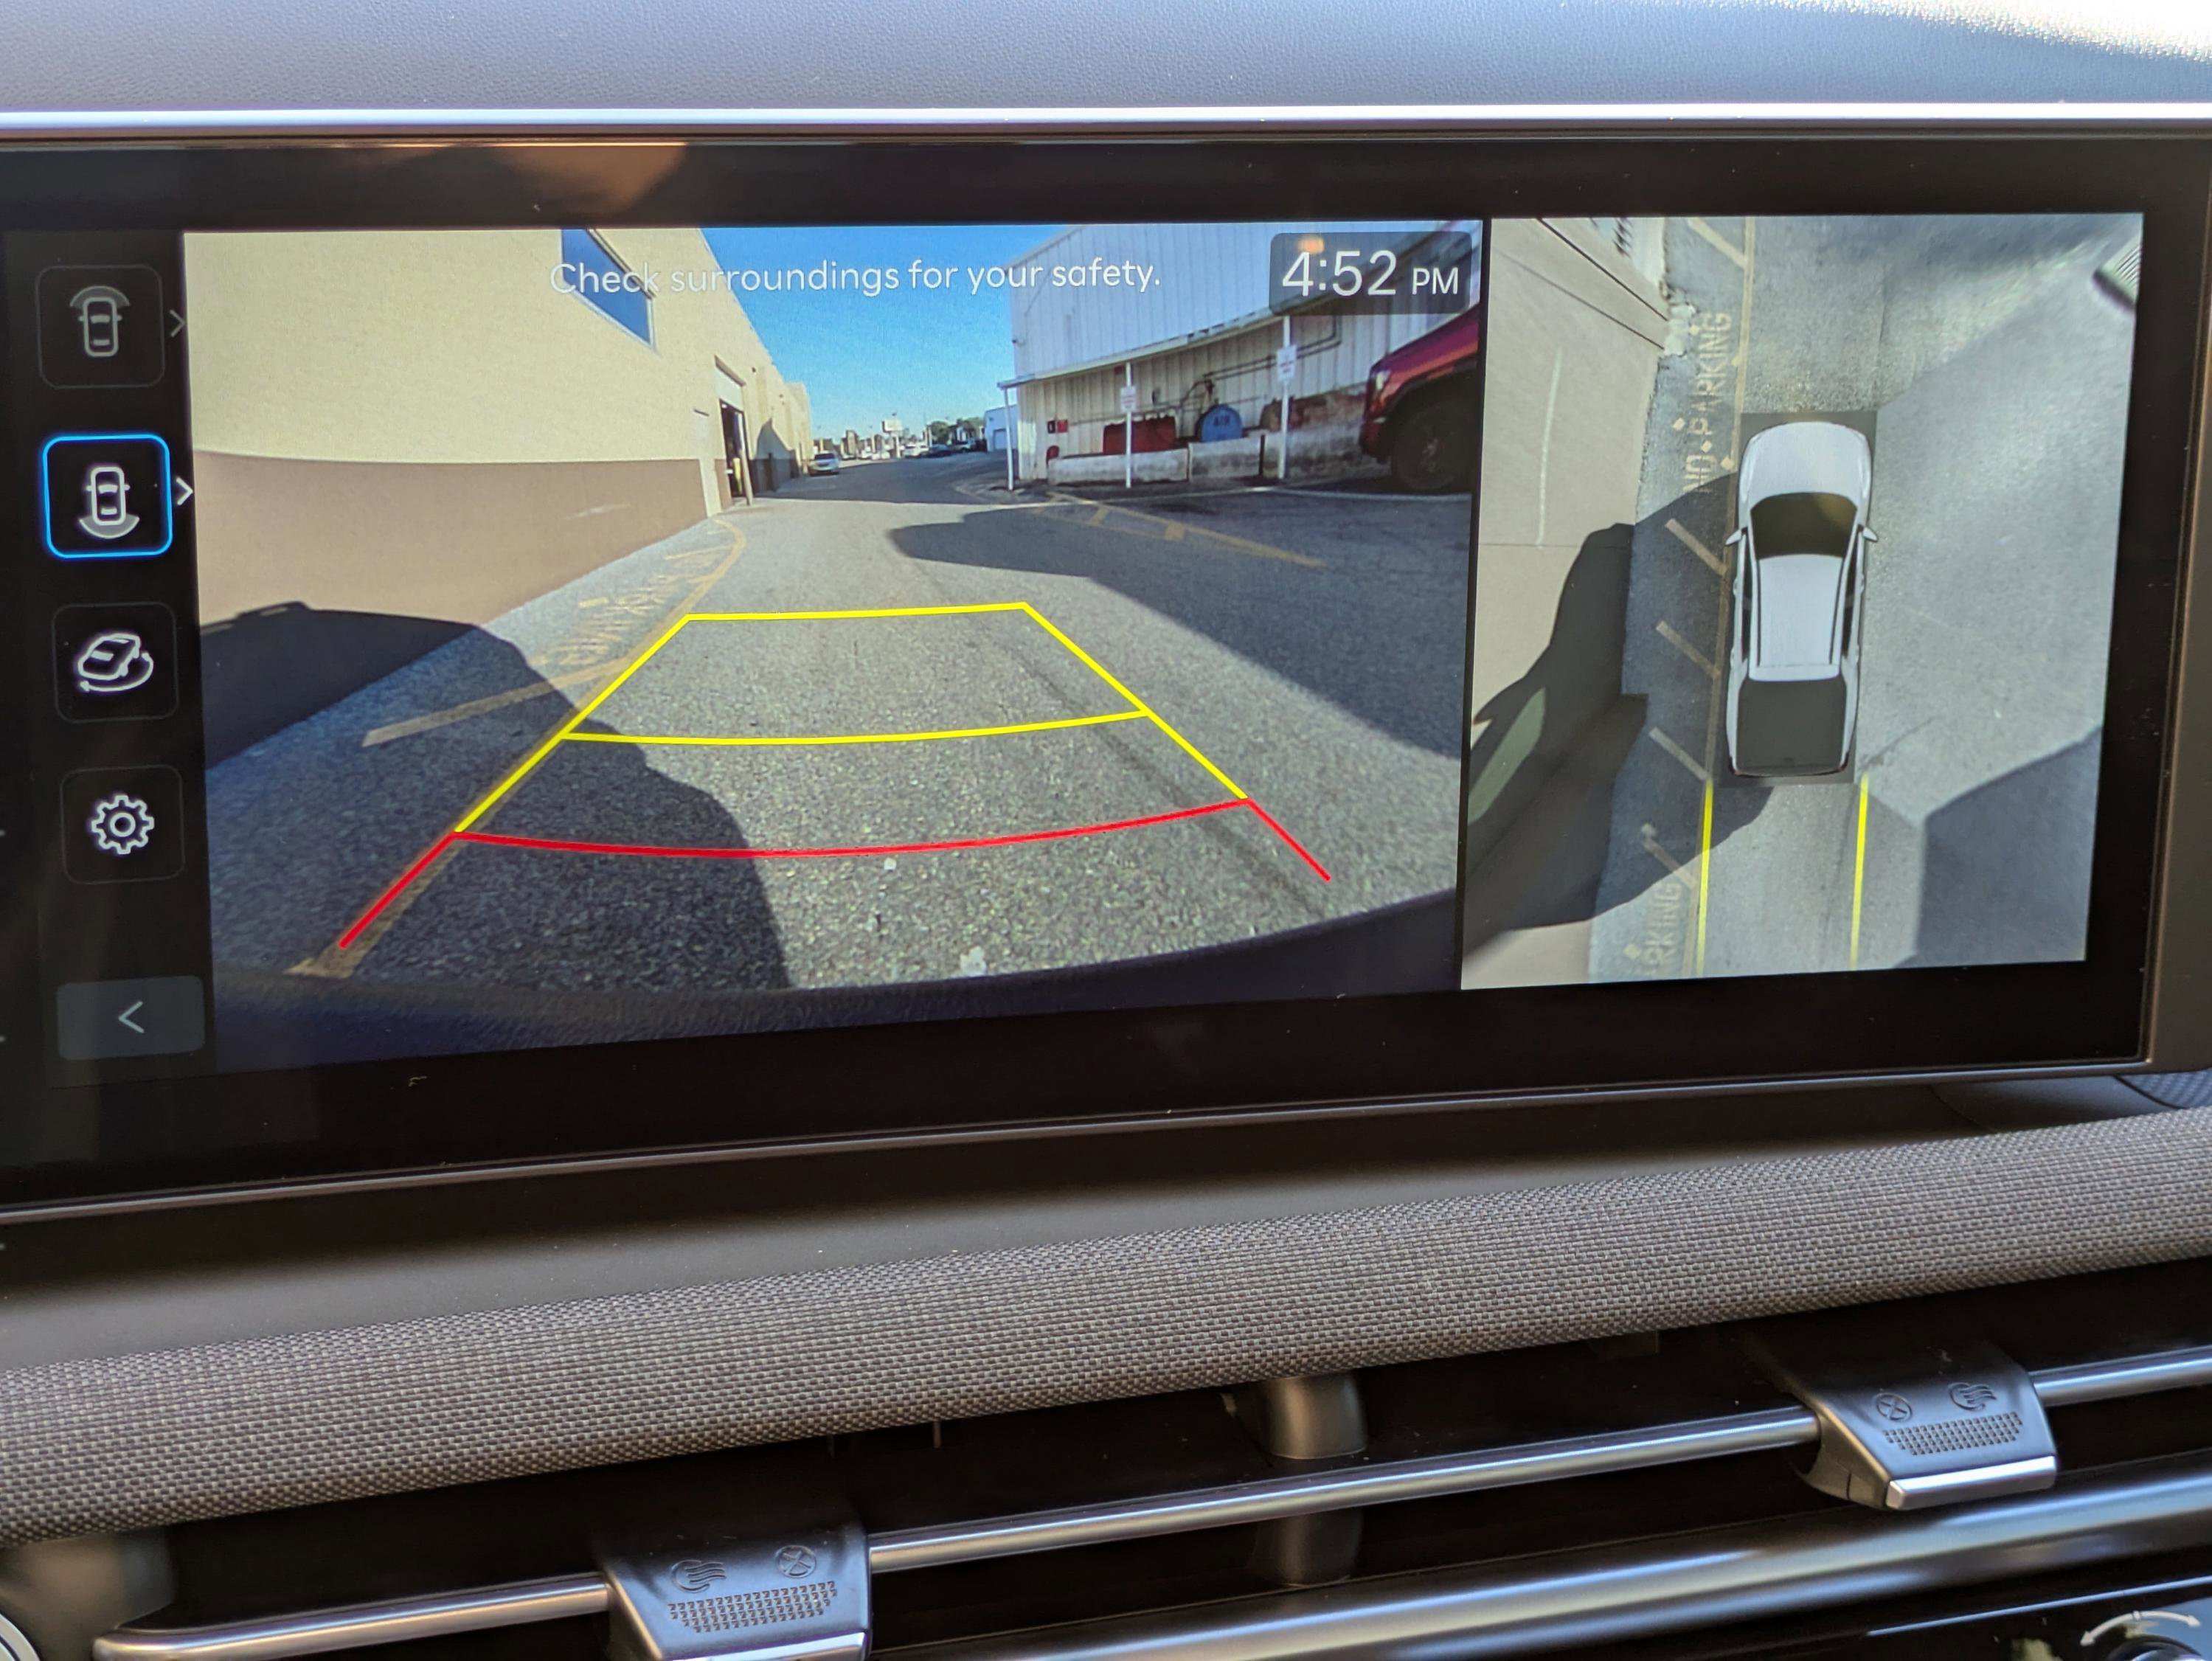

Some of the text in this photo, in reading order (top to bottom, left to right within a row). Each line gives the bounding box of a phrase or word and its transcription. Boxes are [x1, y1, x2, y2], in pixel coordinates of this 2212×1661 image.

[549, 257, 1161, 297] Check surroundings for your safety.
[1282, 249, 1459, 297] 4:52 PM
[1688, 312, 1733, 435] PARKING
